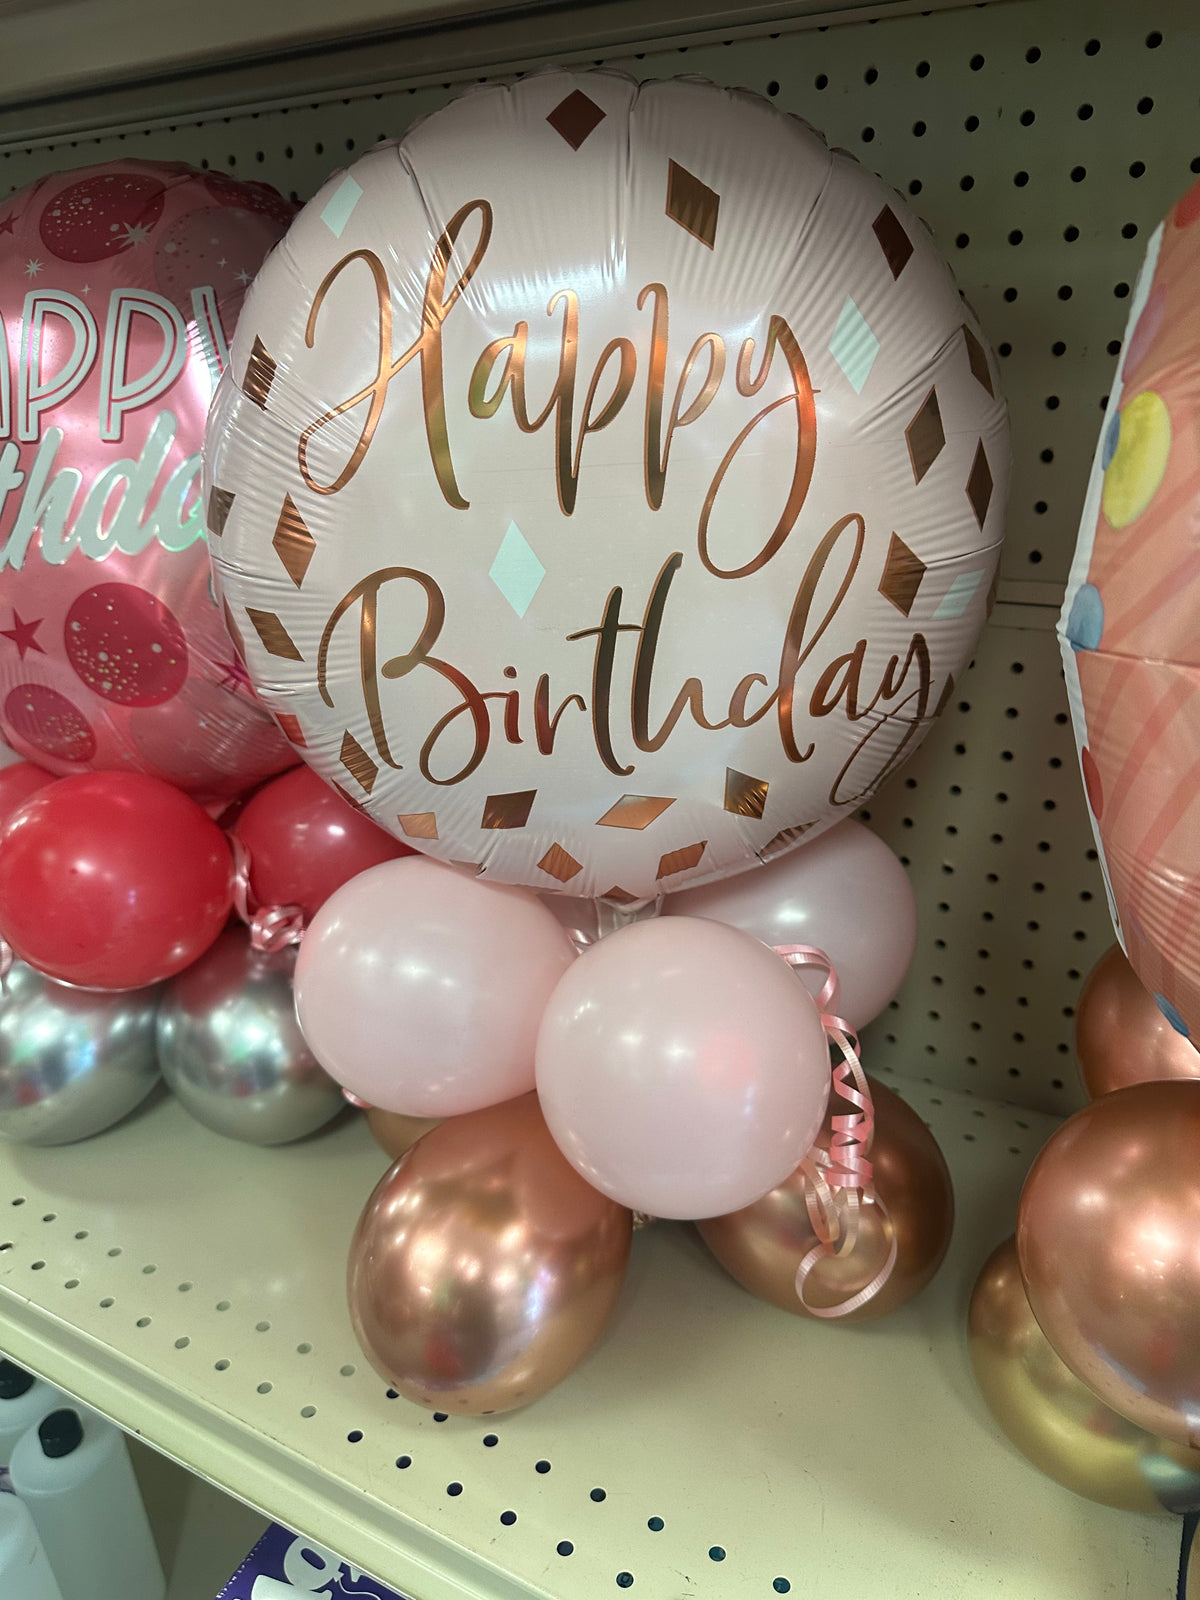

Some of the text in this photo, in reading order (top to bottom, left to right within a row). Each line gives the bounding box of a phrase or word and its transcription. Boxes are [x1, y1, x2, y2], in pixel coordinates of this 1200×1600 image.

[0, 286, 230, 444] PP
[298, 199, 821, 580] Happy
[317, 512, 935, 807] Birthday
